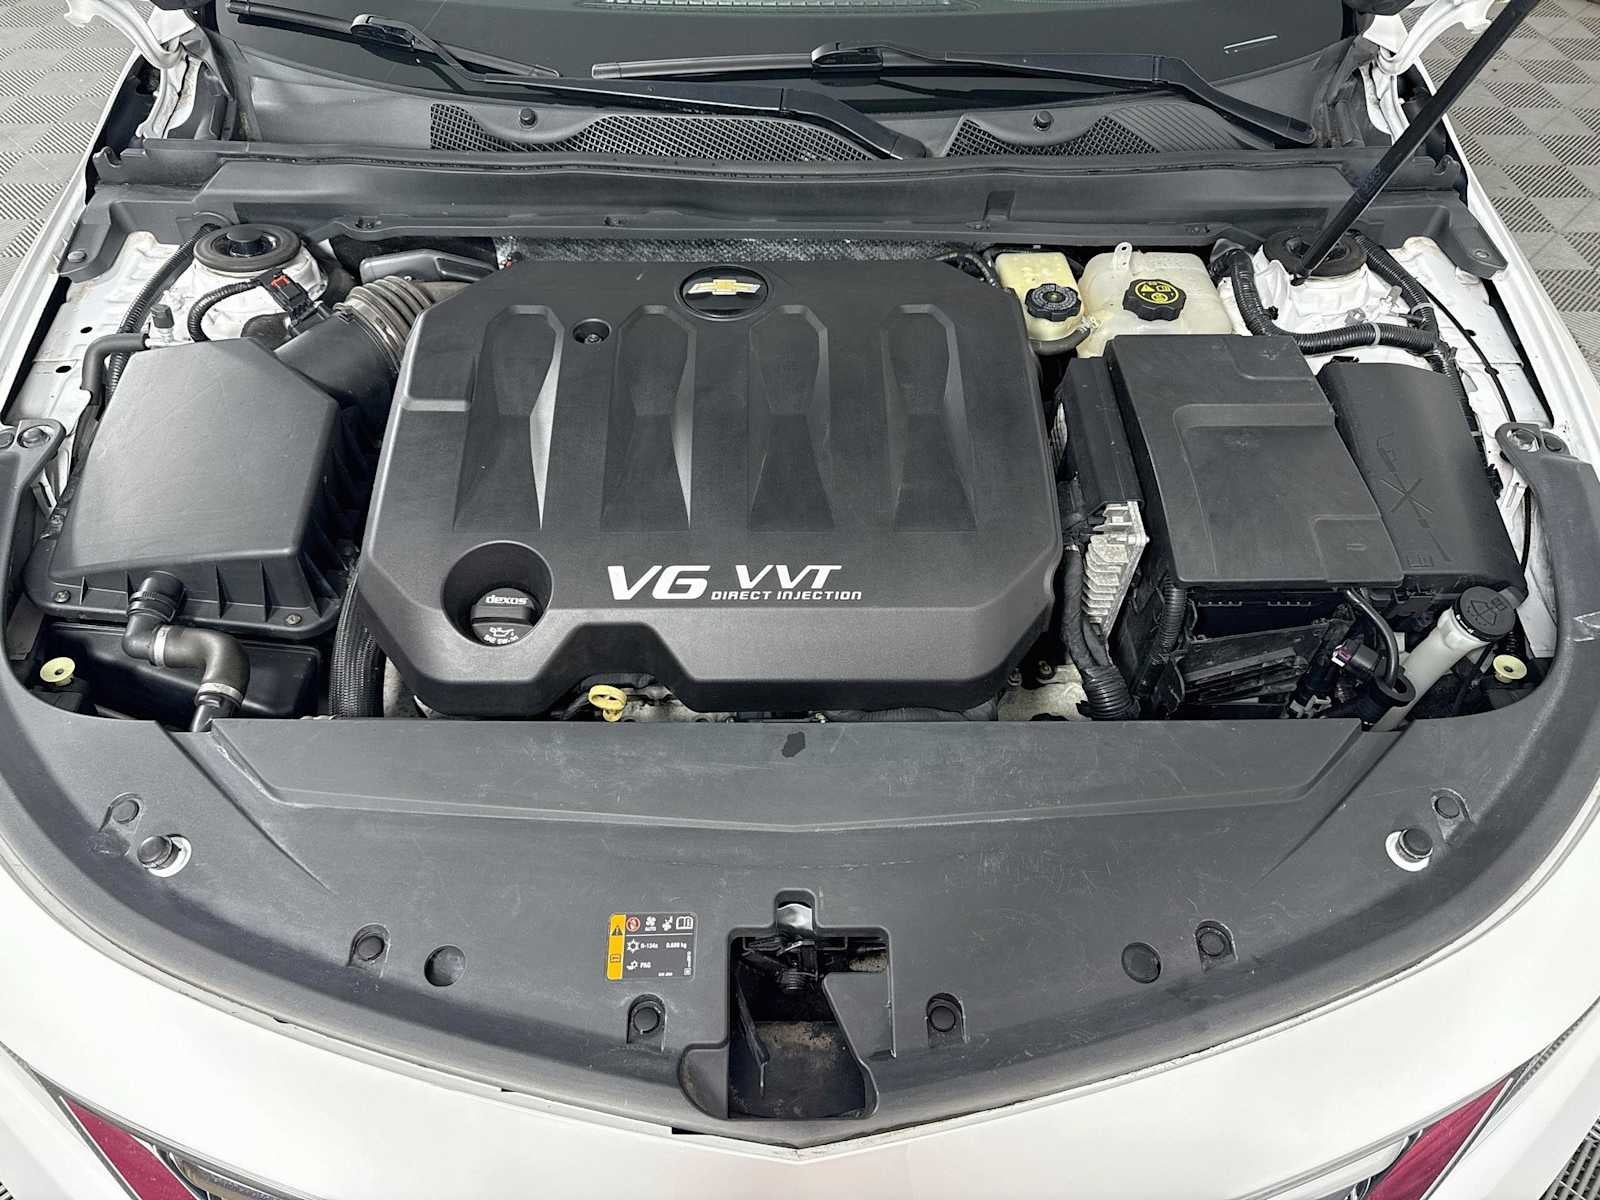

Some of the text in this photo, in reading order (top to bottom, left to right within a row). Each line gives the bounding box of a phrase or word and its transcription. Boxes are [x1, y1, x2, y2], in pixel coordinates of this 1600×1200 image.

[607, 564, 843, 600] V6 VVT
[485, 594, 529, 605] dexos
[711, 590, 862, 600] DIRECT INJECTION
